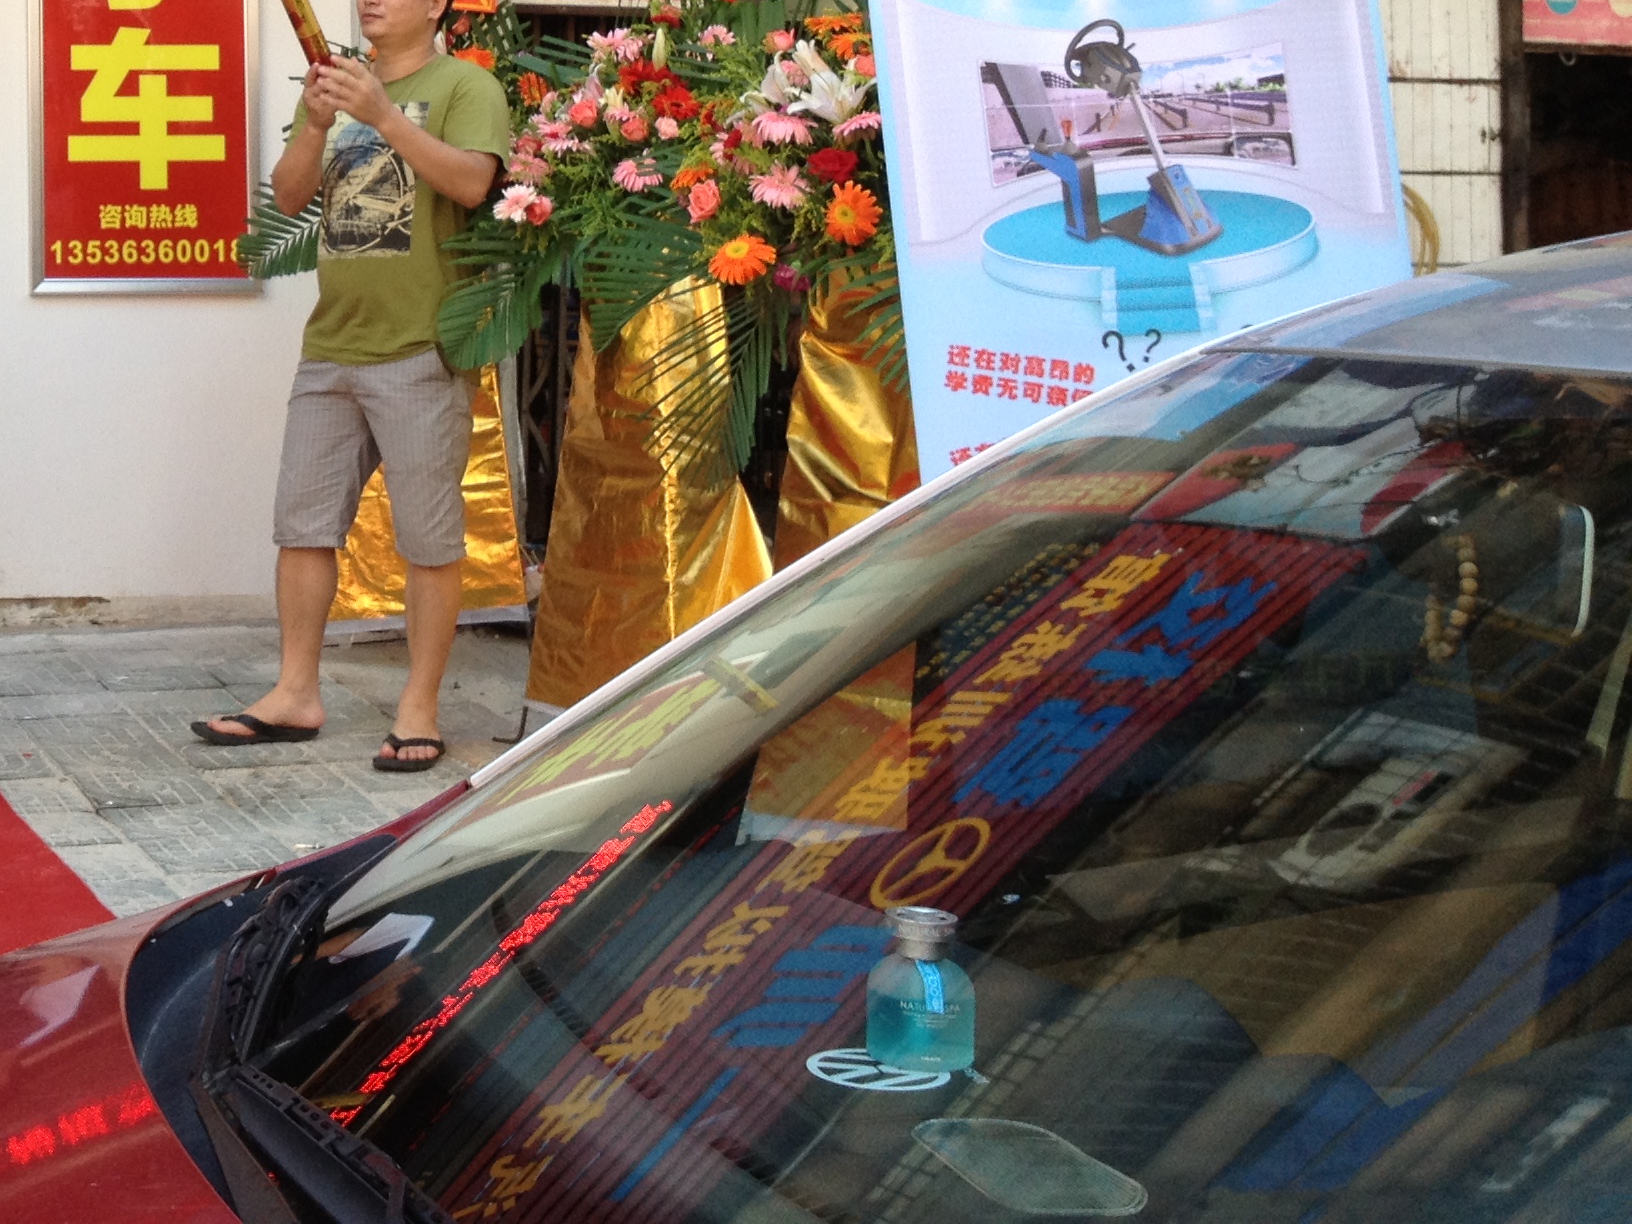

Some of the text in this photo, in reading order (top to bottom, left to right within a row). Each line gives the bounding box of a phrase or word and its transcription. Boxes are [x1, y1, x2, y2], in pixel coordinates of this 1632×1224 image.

[98, 203, 199, 230] 咨询热线
[947, 344, 1096, 386] 还在对高昂的
